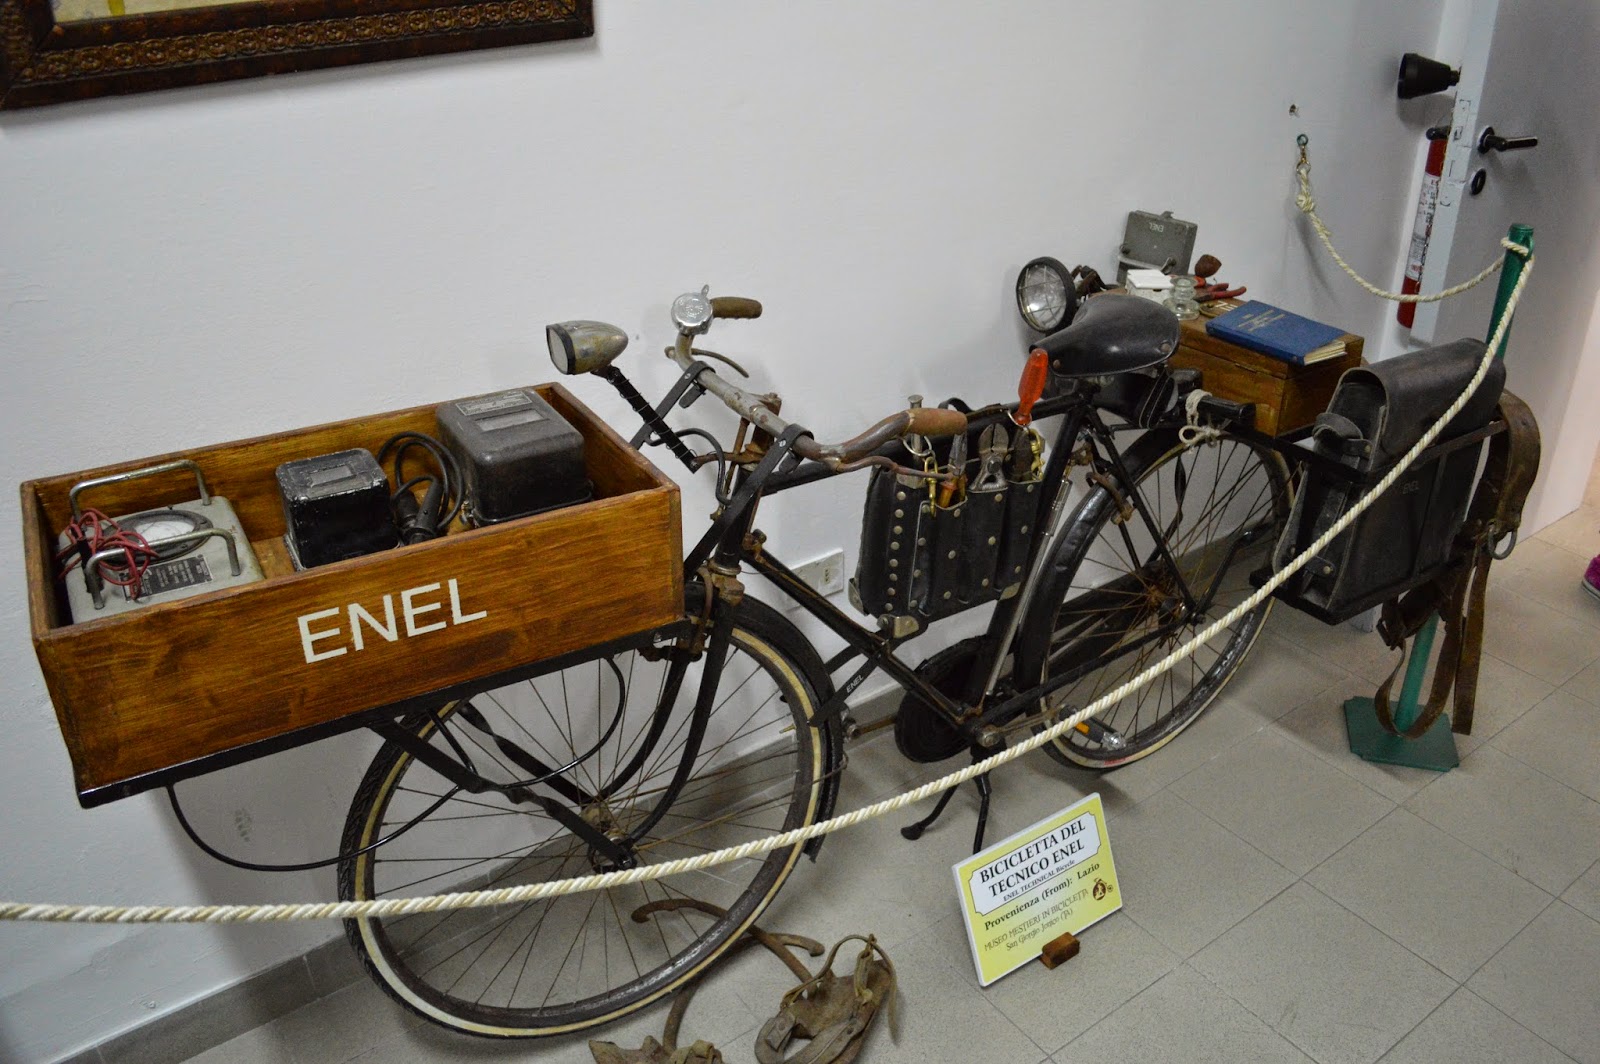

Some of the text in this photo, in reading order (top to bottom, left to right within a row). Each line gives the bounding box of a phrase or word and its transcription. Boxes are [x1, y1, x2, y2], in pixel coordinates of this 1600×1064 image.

[298, 578, 488, 664] ENEL
[846, 674, 864, 693] ENEL
[980, 819, 1086, 884] BICICLETTA DEL
[988, 839, 1085, 897] TECNICO ENEL
[984, 863, 1100, 931] Provenienza (From): Lazio
[1003, 890, 1020, 902] ENEL
[1020, 872, 1056, 893] TECHNICAL
[984, 888, 1090, 952] MUSEO MESTIERI IN BICICLETTA
[1005, 940, 1019, 952] San
[1018, 926, 1041, 944] Giorgio
[1060, 908, 1074, 922] (TA)
